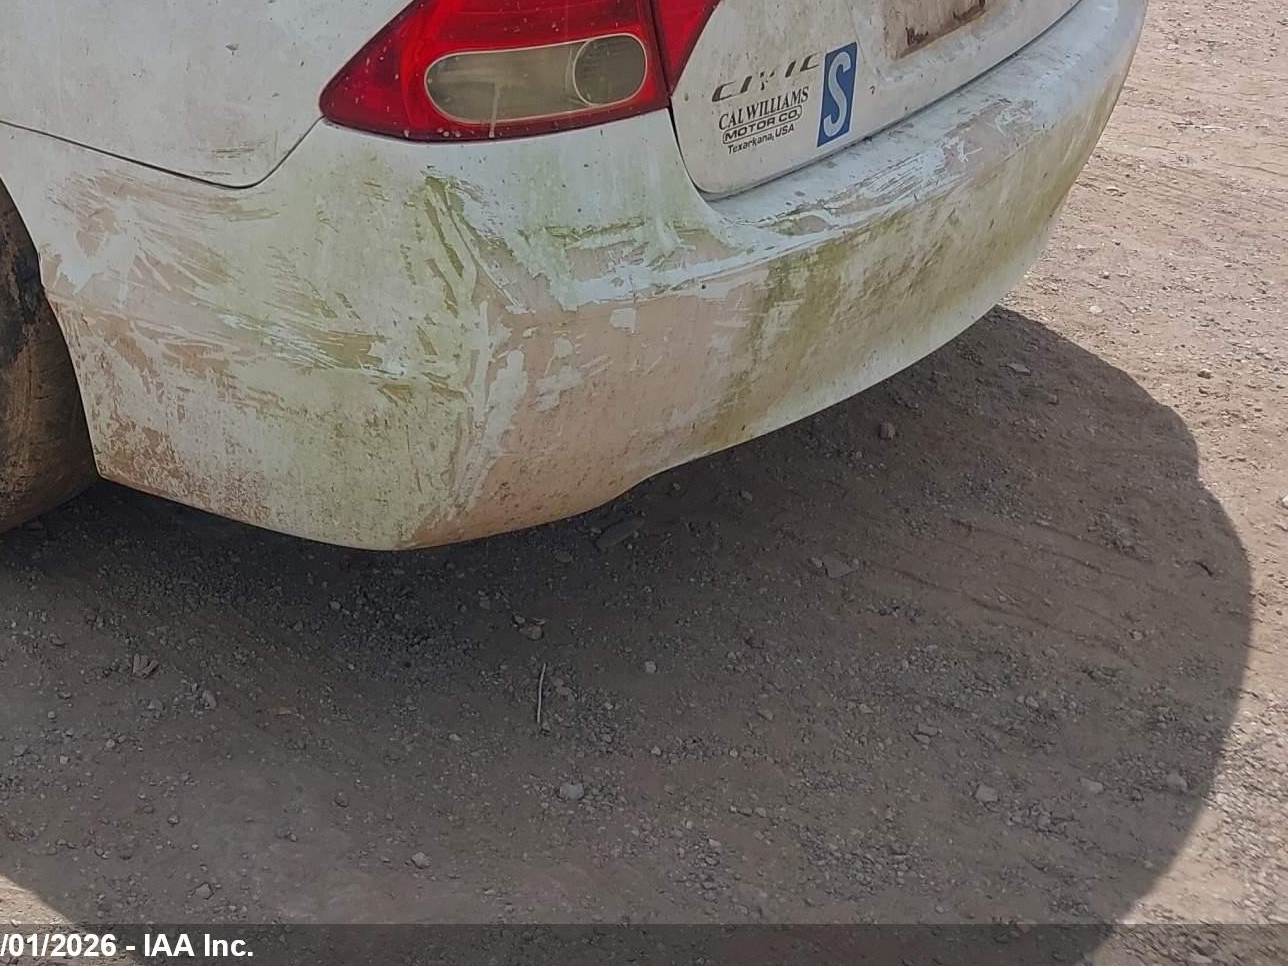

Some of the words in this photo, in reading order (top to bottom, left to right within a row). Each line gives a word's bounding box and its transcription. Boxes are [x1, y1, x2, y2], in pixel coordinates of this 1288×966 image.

[718, 107, 745, 130] CAL
[745, 86, 809, 122] WILLIAMS
[724, 115, 776, 141] MOTOR
[727, 133, 775, 155] Texarkana,
[775, 123, 795, 138] USA
